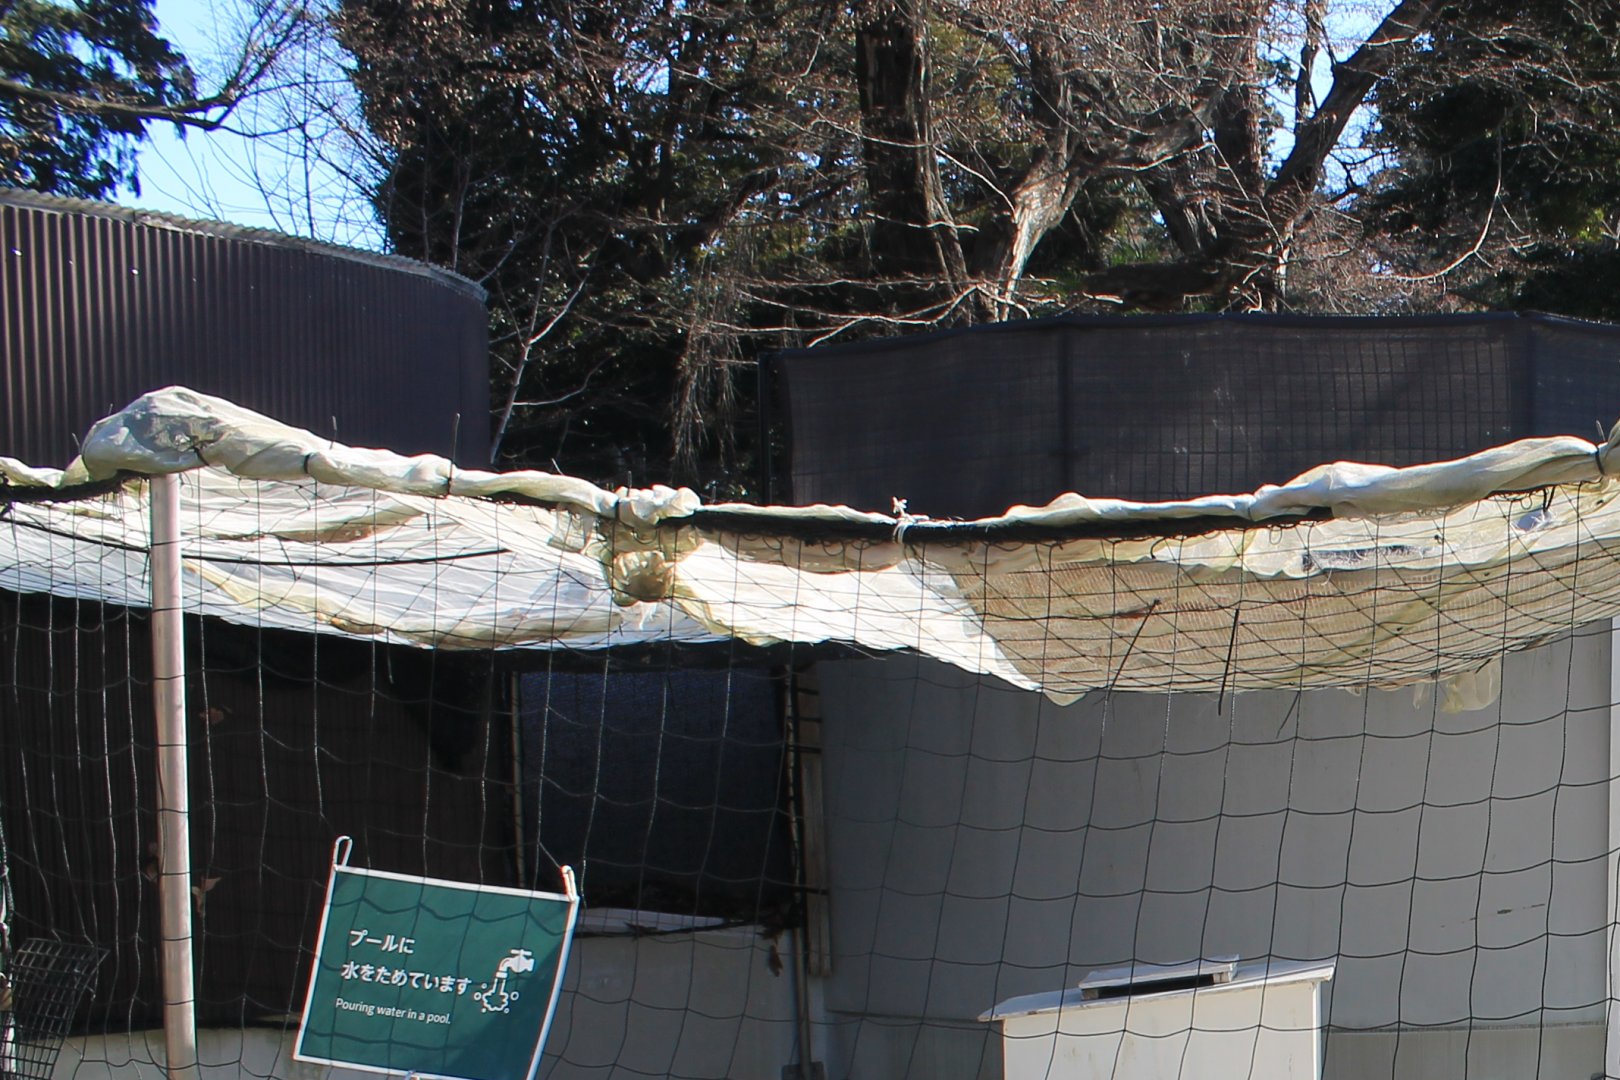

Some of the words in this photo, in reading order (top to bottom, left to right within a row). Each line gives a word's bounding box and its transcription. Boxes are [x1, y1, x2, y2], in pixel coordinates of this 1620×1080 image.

[350, 929, 416, 954] プールに
[341, 960, 473, 995] 水をためています
[335, 997, 376, 1017] Pouring
[376, 1005, 404, 1018] water
[407, 1008, 417, 1019] in
[418, 1012, 425, 1021] a
[426, 1013, 451, 1025] pool.
